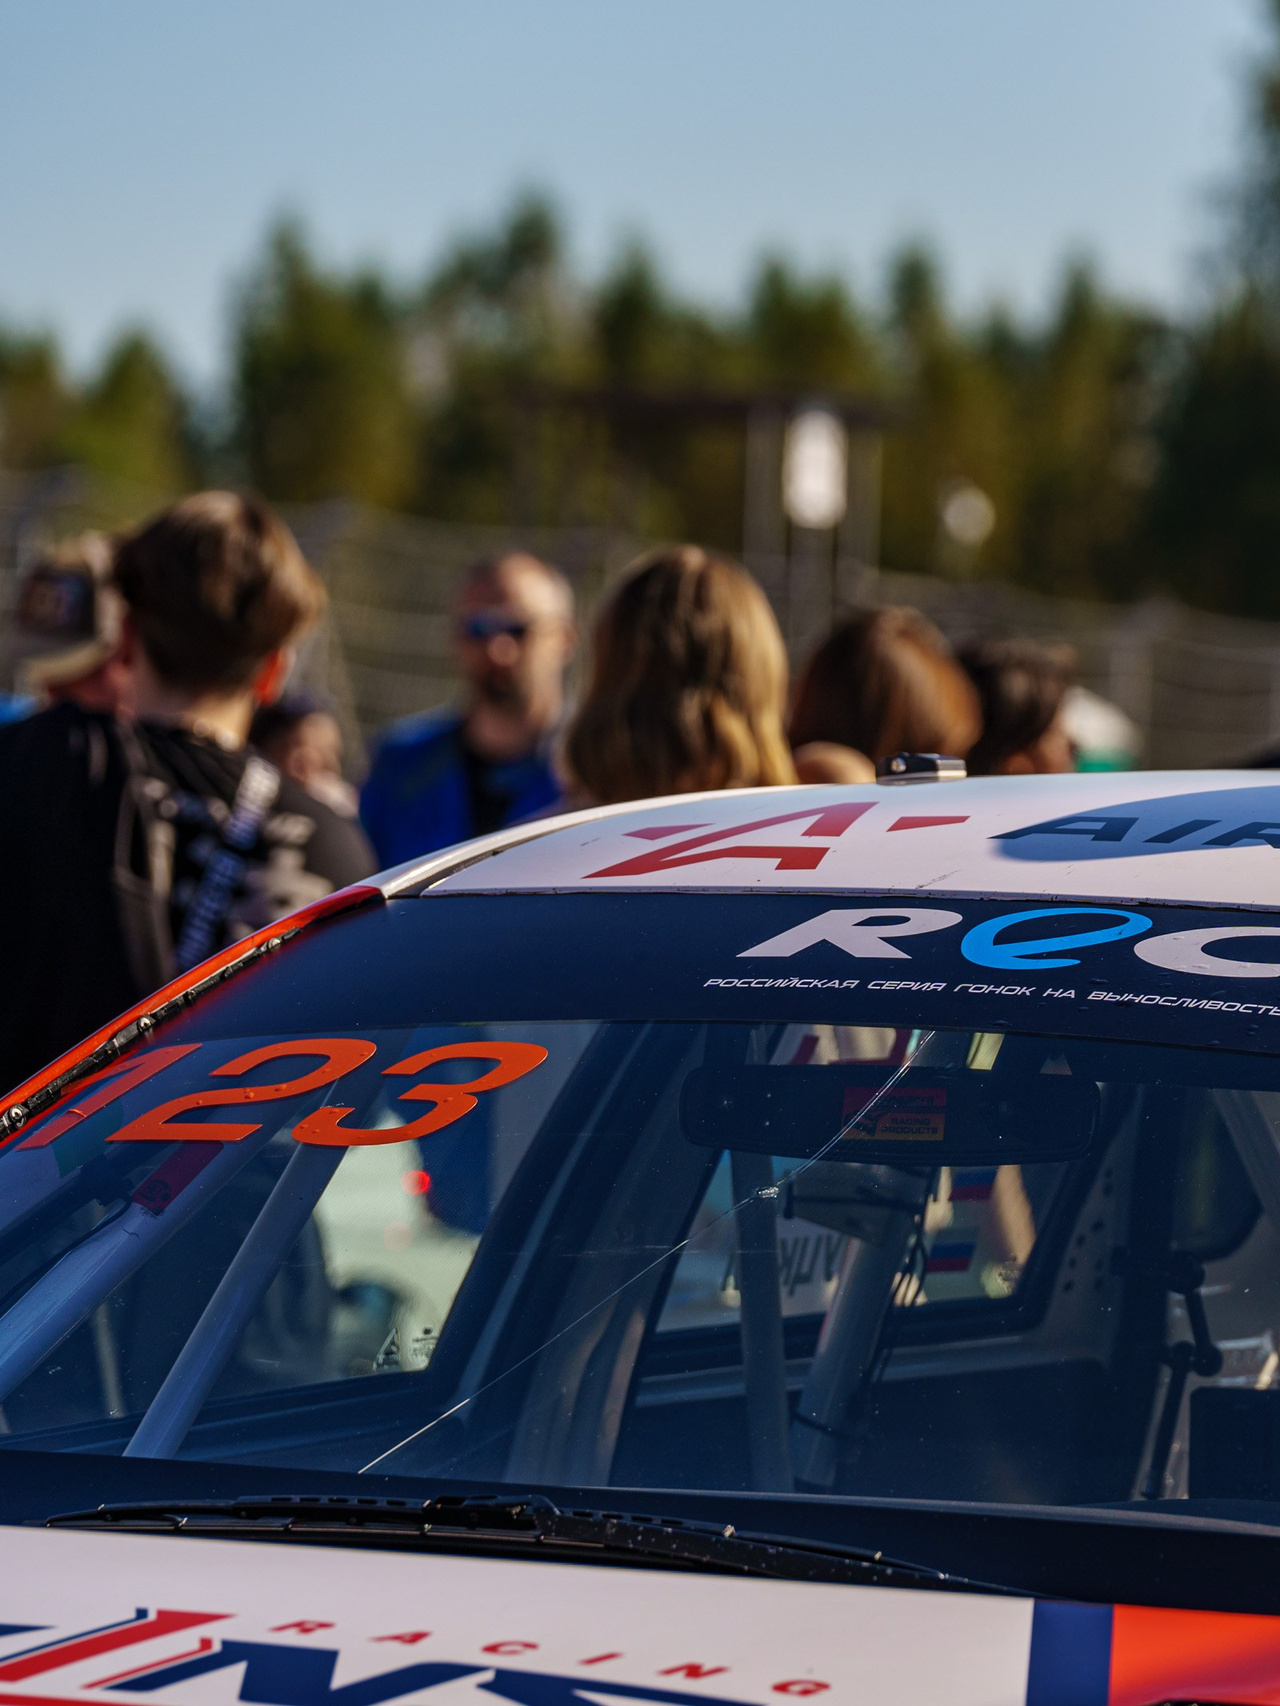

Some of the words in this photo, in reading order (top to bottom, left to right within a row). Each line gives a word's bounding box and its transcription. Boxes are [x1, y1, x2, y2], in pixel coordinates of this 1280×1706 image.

[703, 974, 860, 990] РОССИЙСКАЯ
[867, 979, 948, 994] СЕРИЯ
[953, 983, 1036, 998] ГОНОК
[1042, 986, 1078, 1000] НА
[16, 1038, 549, 1151] 123
[268, 1619, 831, 1697] RACING
